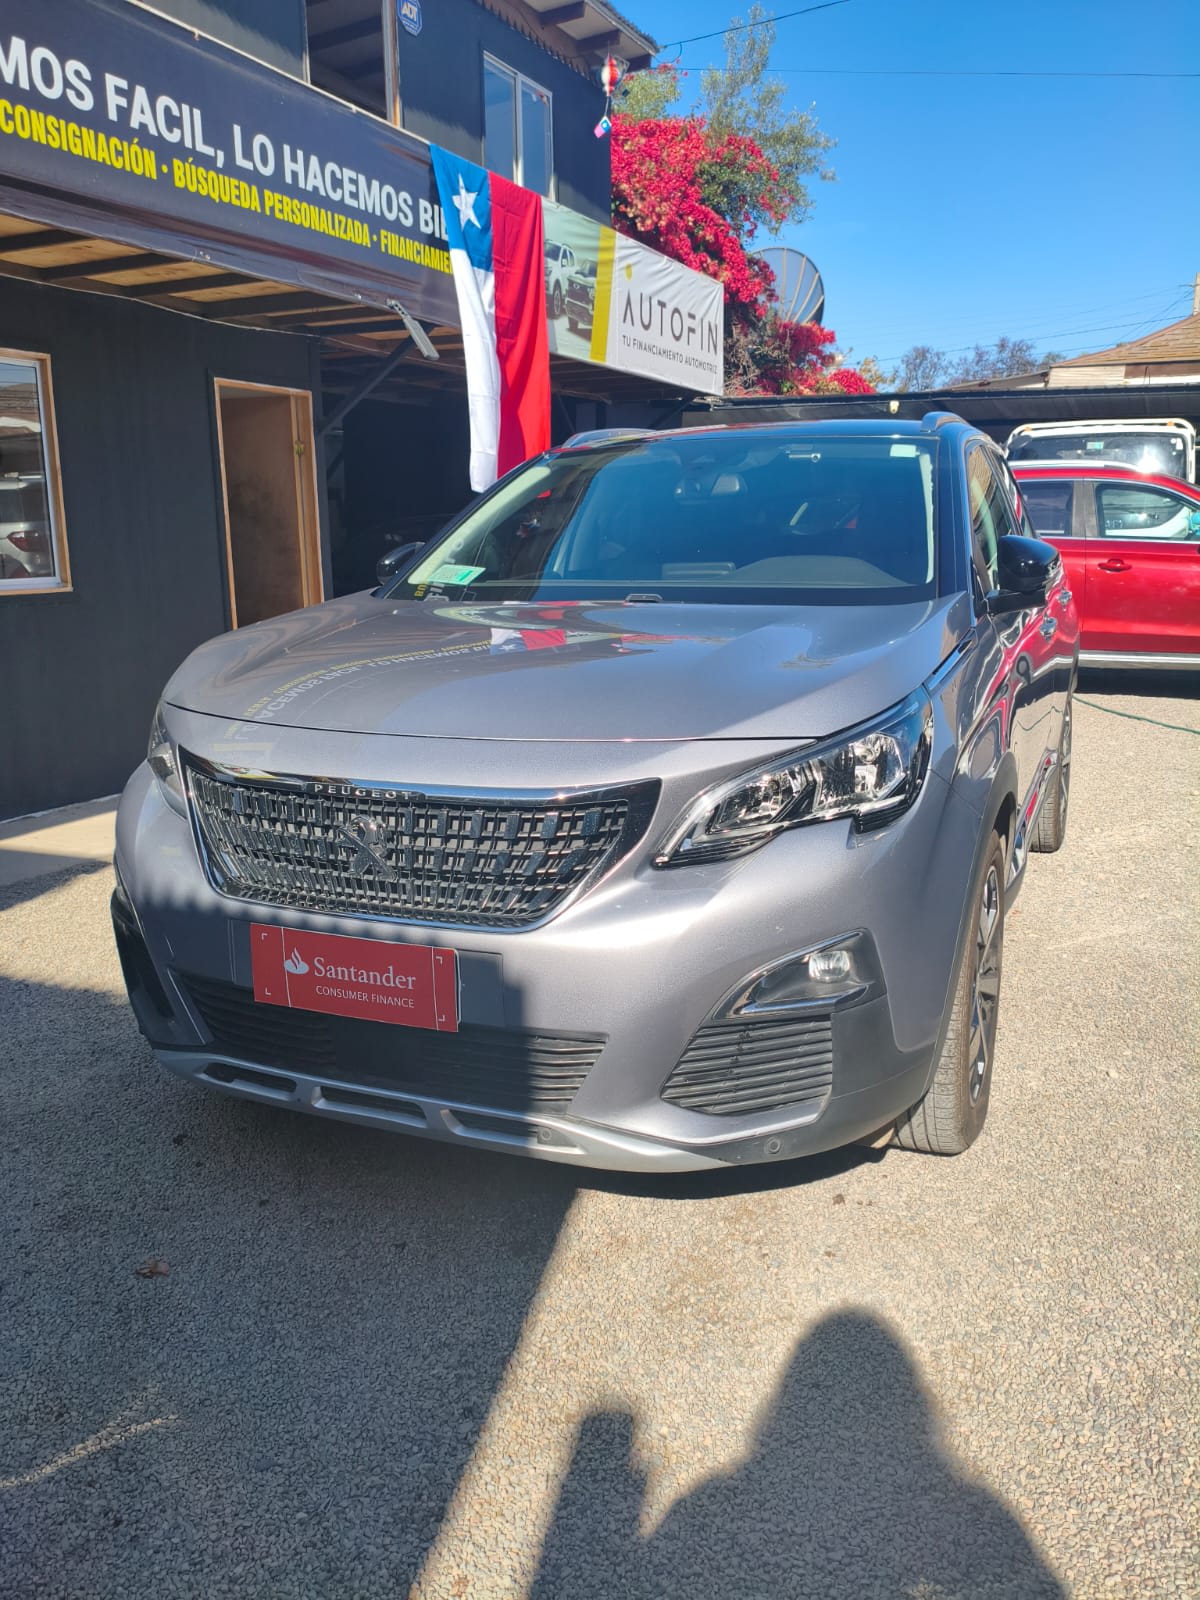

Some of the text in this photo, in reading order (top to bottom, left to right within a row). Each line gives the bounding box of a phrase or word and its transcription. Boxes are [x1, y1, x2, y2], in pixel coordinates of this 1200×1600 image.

[105, 73, 225, 168] FACIL,
[233, 124, 275, 176] LO
[283, 144, 413, 227] HACEMOS
[0, 99, 157, 180] CONSIGNACIÓN
[172, 157, 261, 213] BÚSQUEDA
[263, 189, 371, 248] PERSONALIZADA
[622, 289, 718, 356] AUTOFIN
[622, 334, 718, 375] TU FINANCIAMIENTO AUTOMOTRIZ
[314, 784, 412, 800] PEUGEOT
[313, 956, 416, 991] Santander
[316, 985, 415, 1009] CONSUMER FINANCE
